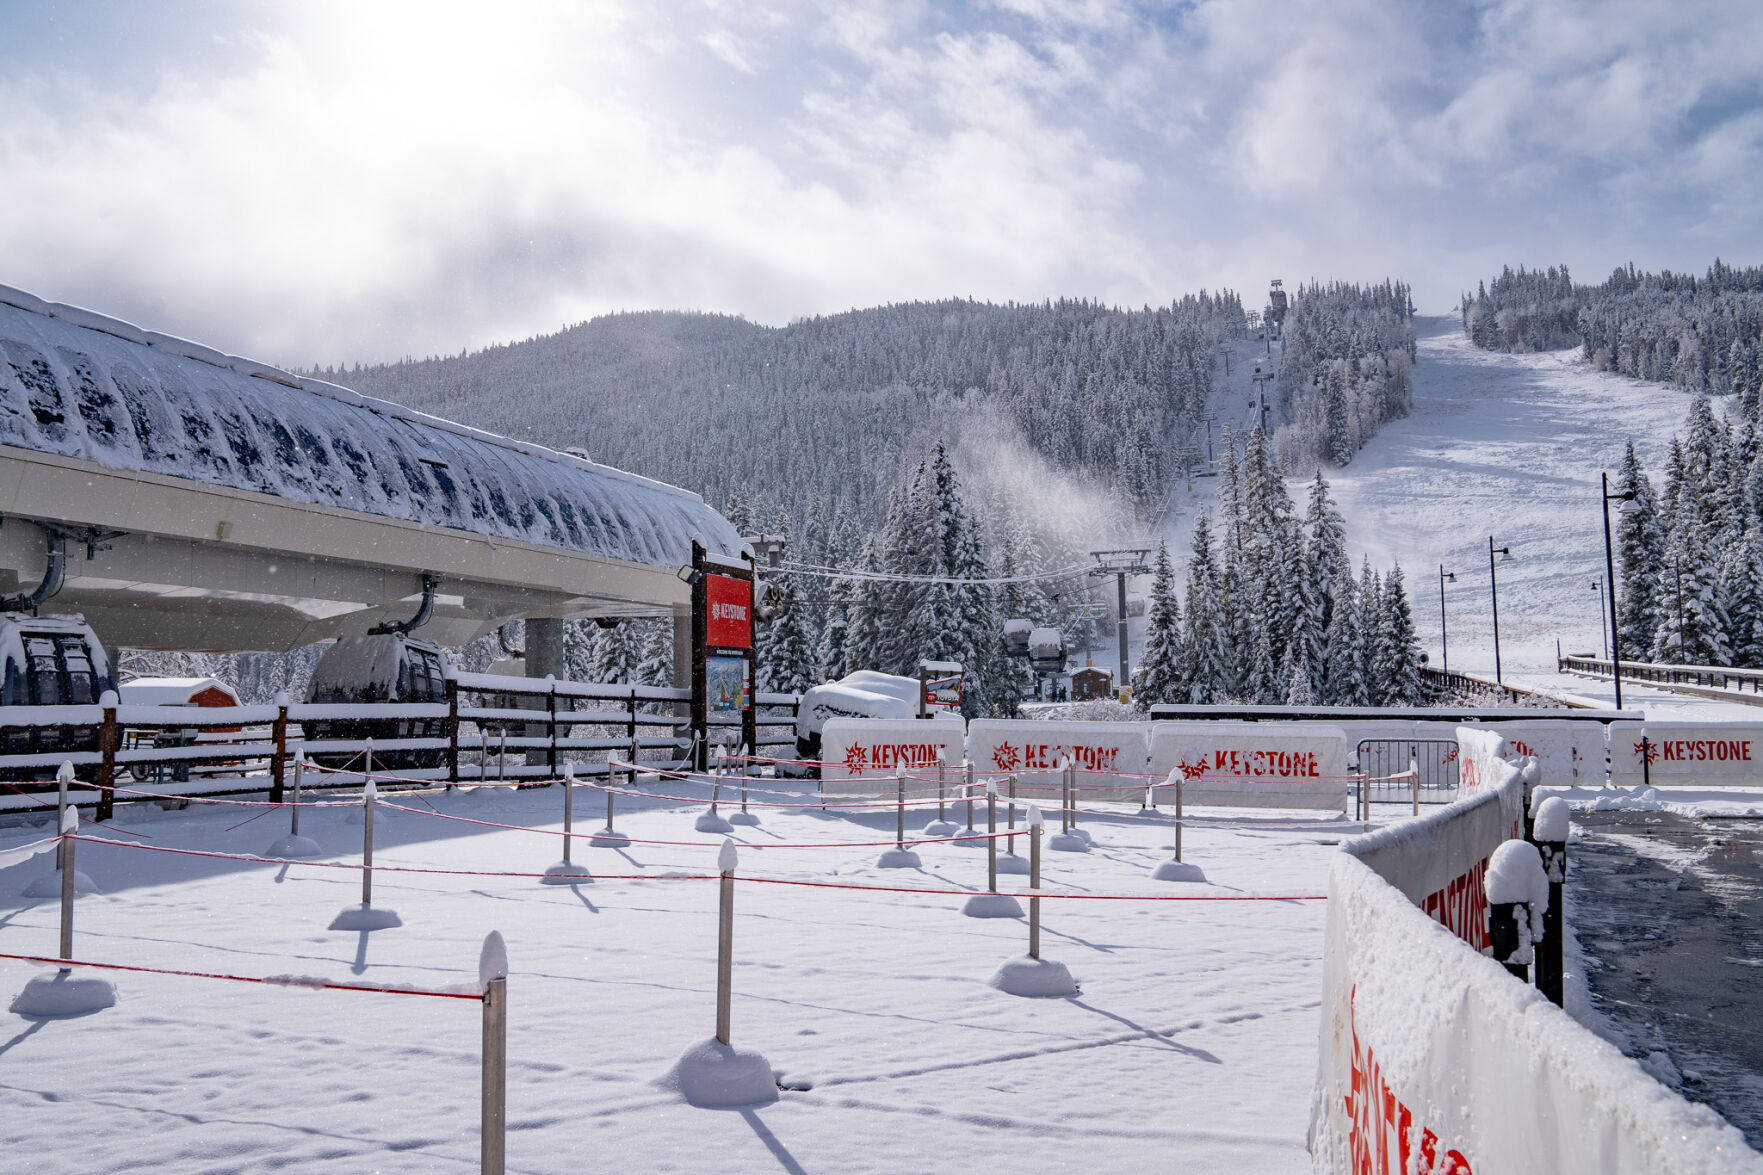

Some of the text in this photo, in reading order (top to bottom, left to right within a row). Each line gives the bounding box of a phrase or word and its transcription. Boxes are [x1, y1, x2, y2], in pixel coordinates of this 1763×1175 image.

[720, 603, 747, 621] KEYSTONE
[871, 744, 946, 769] KEYSTON
[1664, 740, 1752, 761] KEYSTONE
